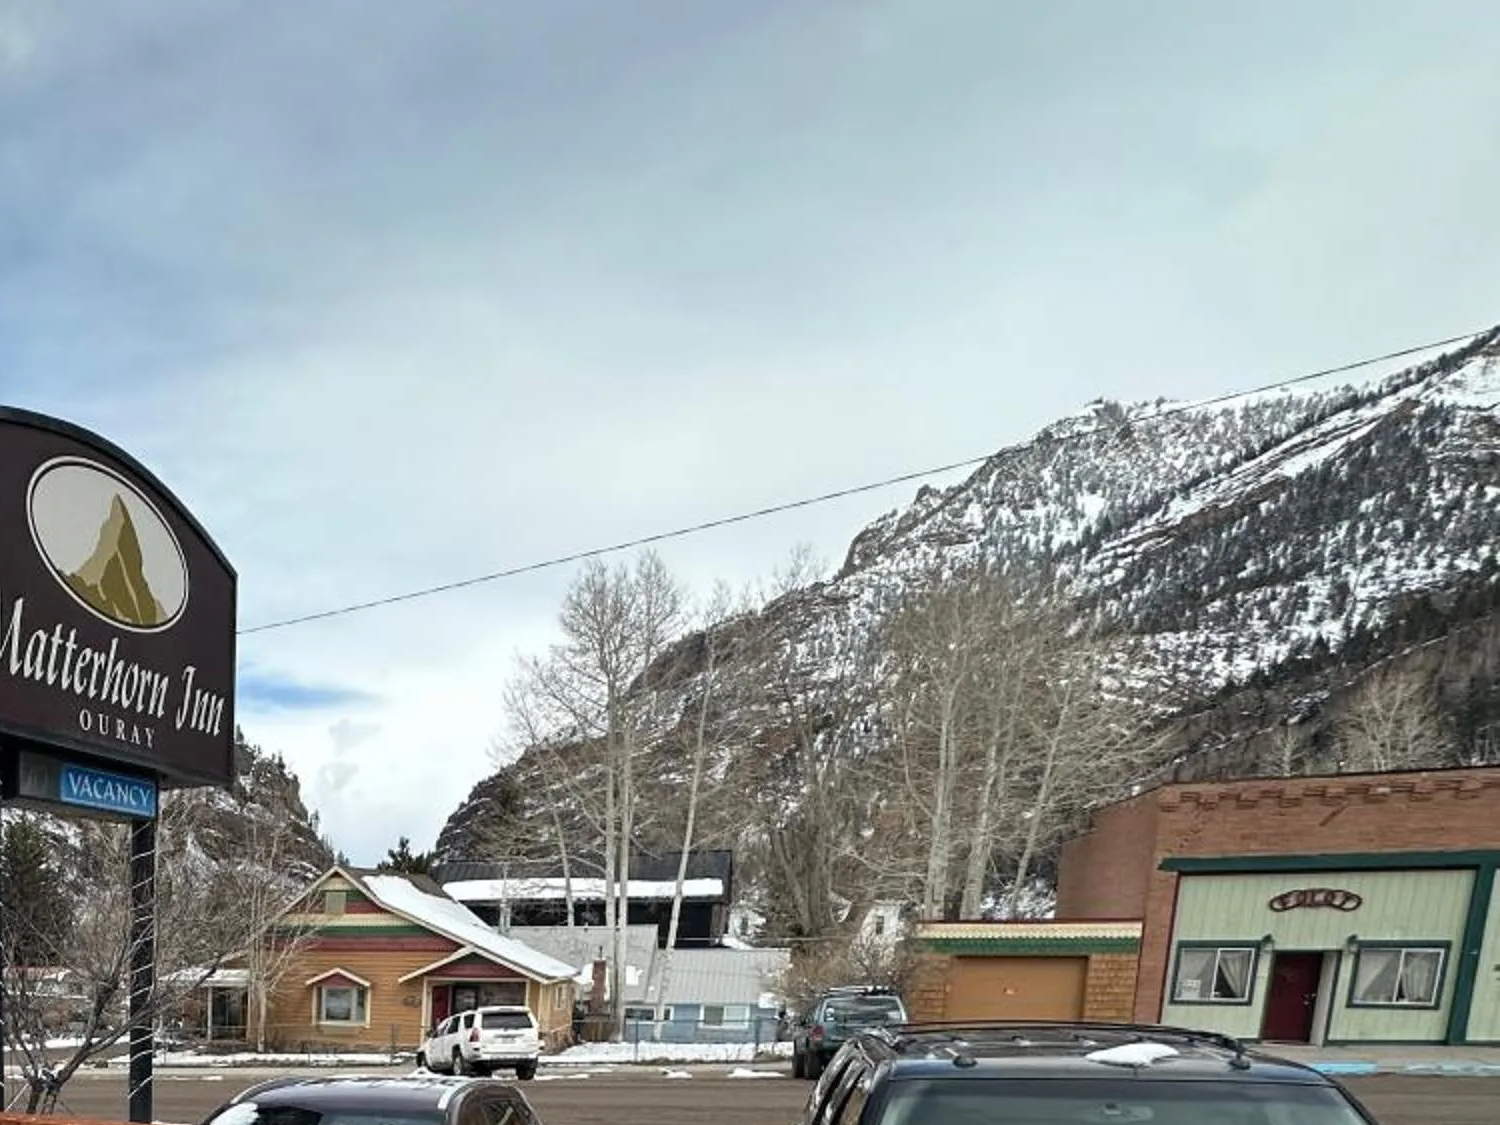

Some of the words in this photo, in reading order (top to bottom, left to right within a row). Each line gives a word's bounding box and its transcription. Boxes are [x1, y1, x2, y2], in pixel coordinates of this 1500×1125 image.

[175, 665, 225, 736] Inn
[79, 708, 156, 749] OURAY
[67, 771, 150, 808] VACANCY
